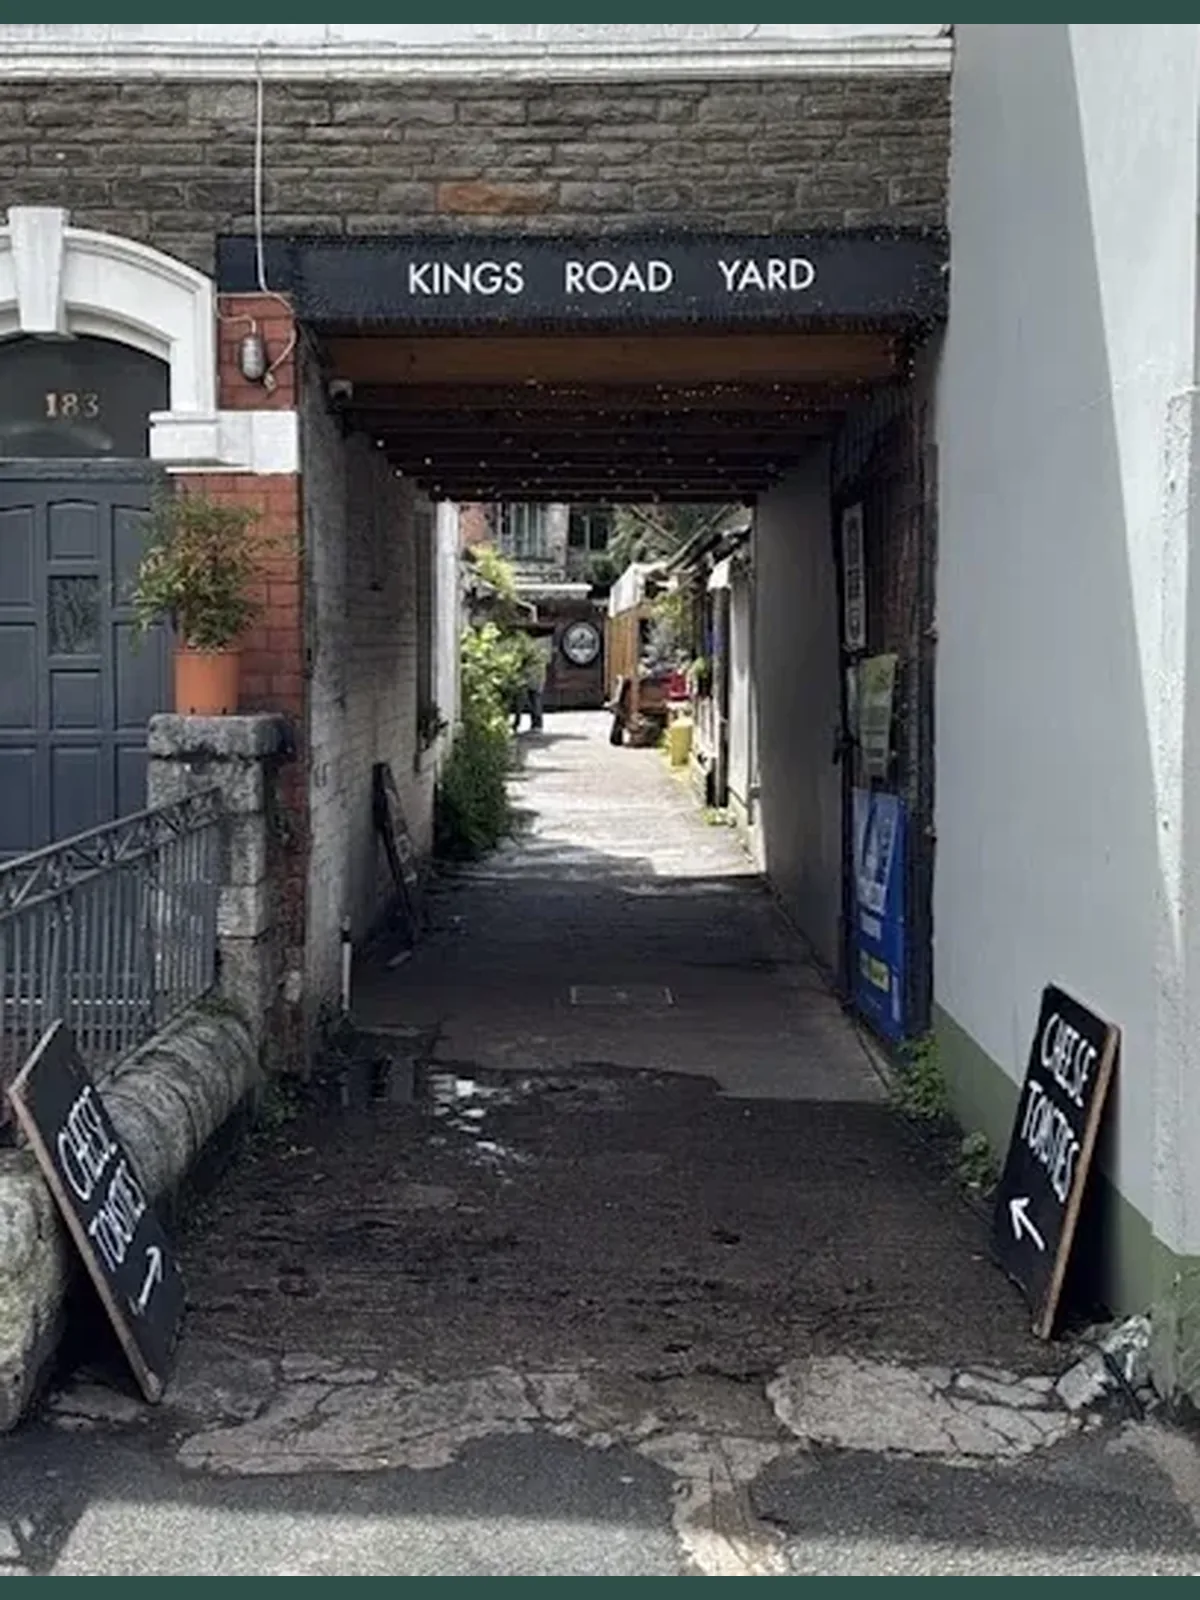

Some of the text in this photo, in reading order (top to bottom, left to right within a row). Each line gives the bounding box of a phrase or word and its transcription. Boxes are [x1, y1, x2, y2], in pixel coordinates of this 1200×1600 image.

[408, 257, 816, 296] KINGS ROAD YARD
[46, 392, 99, 419] 183
